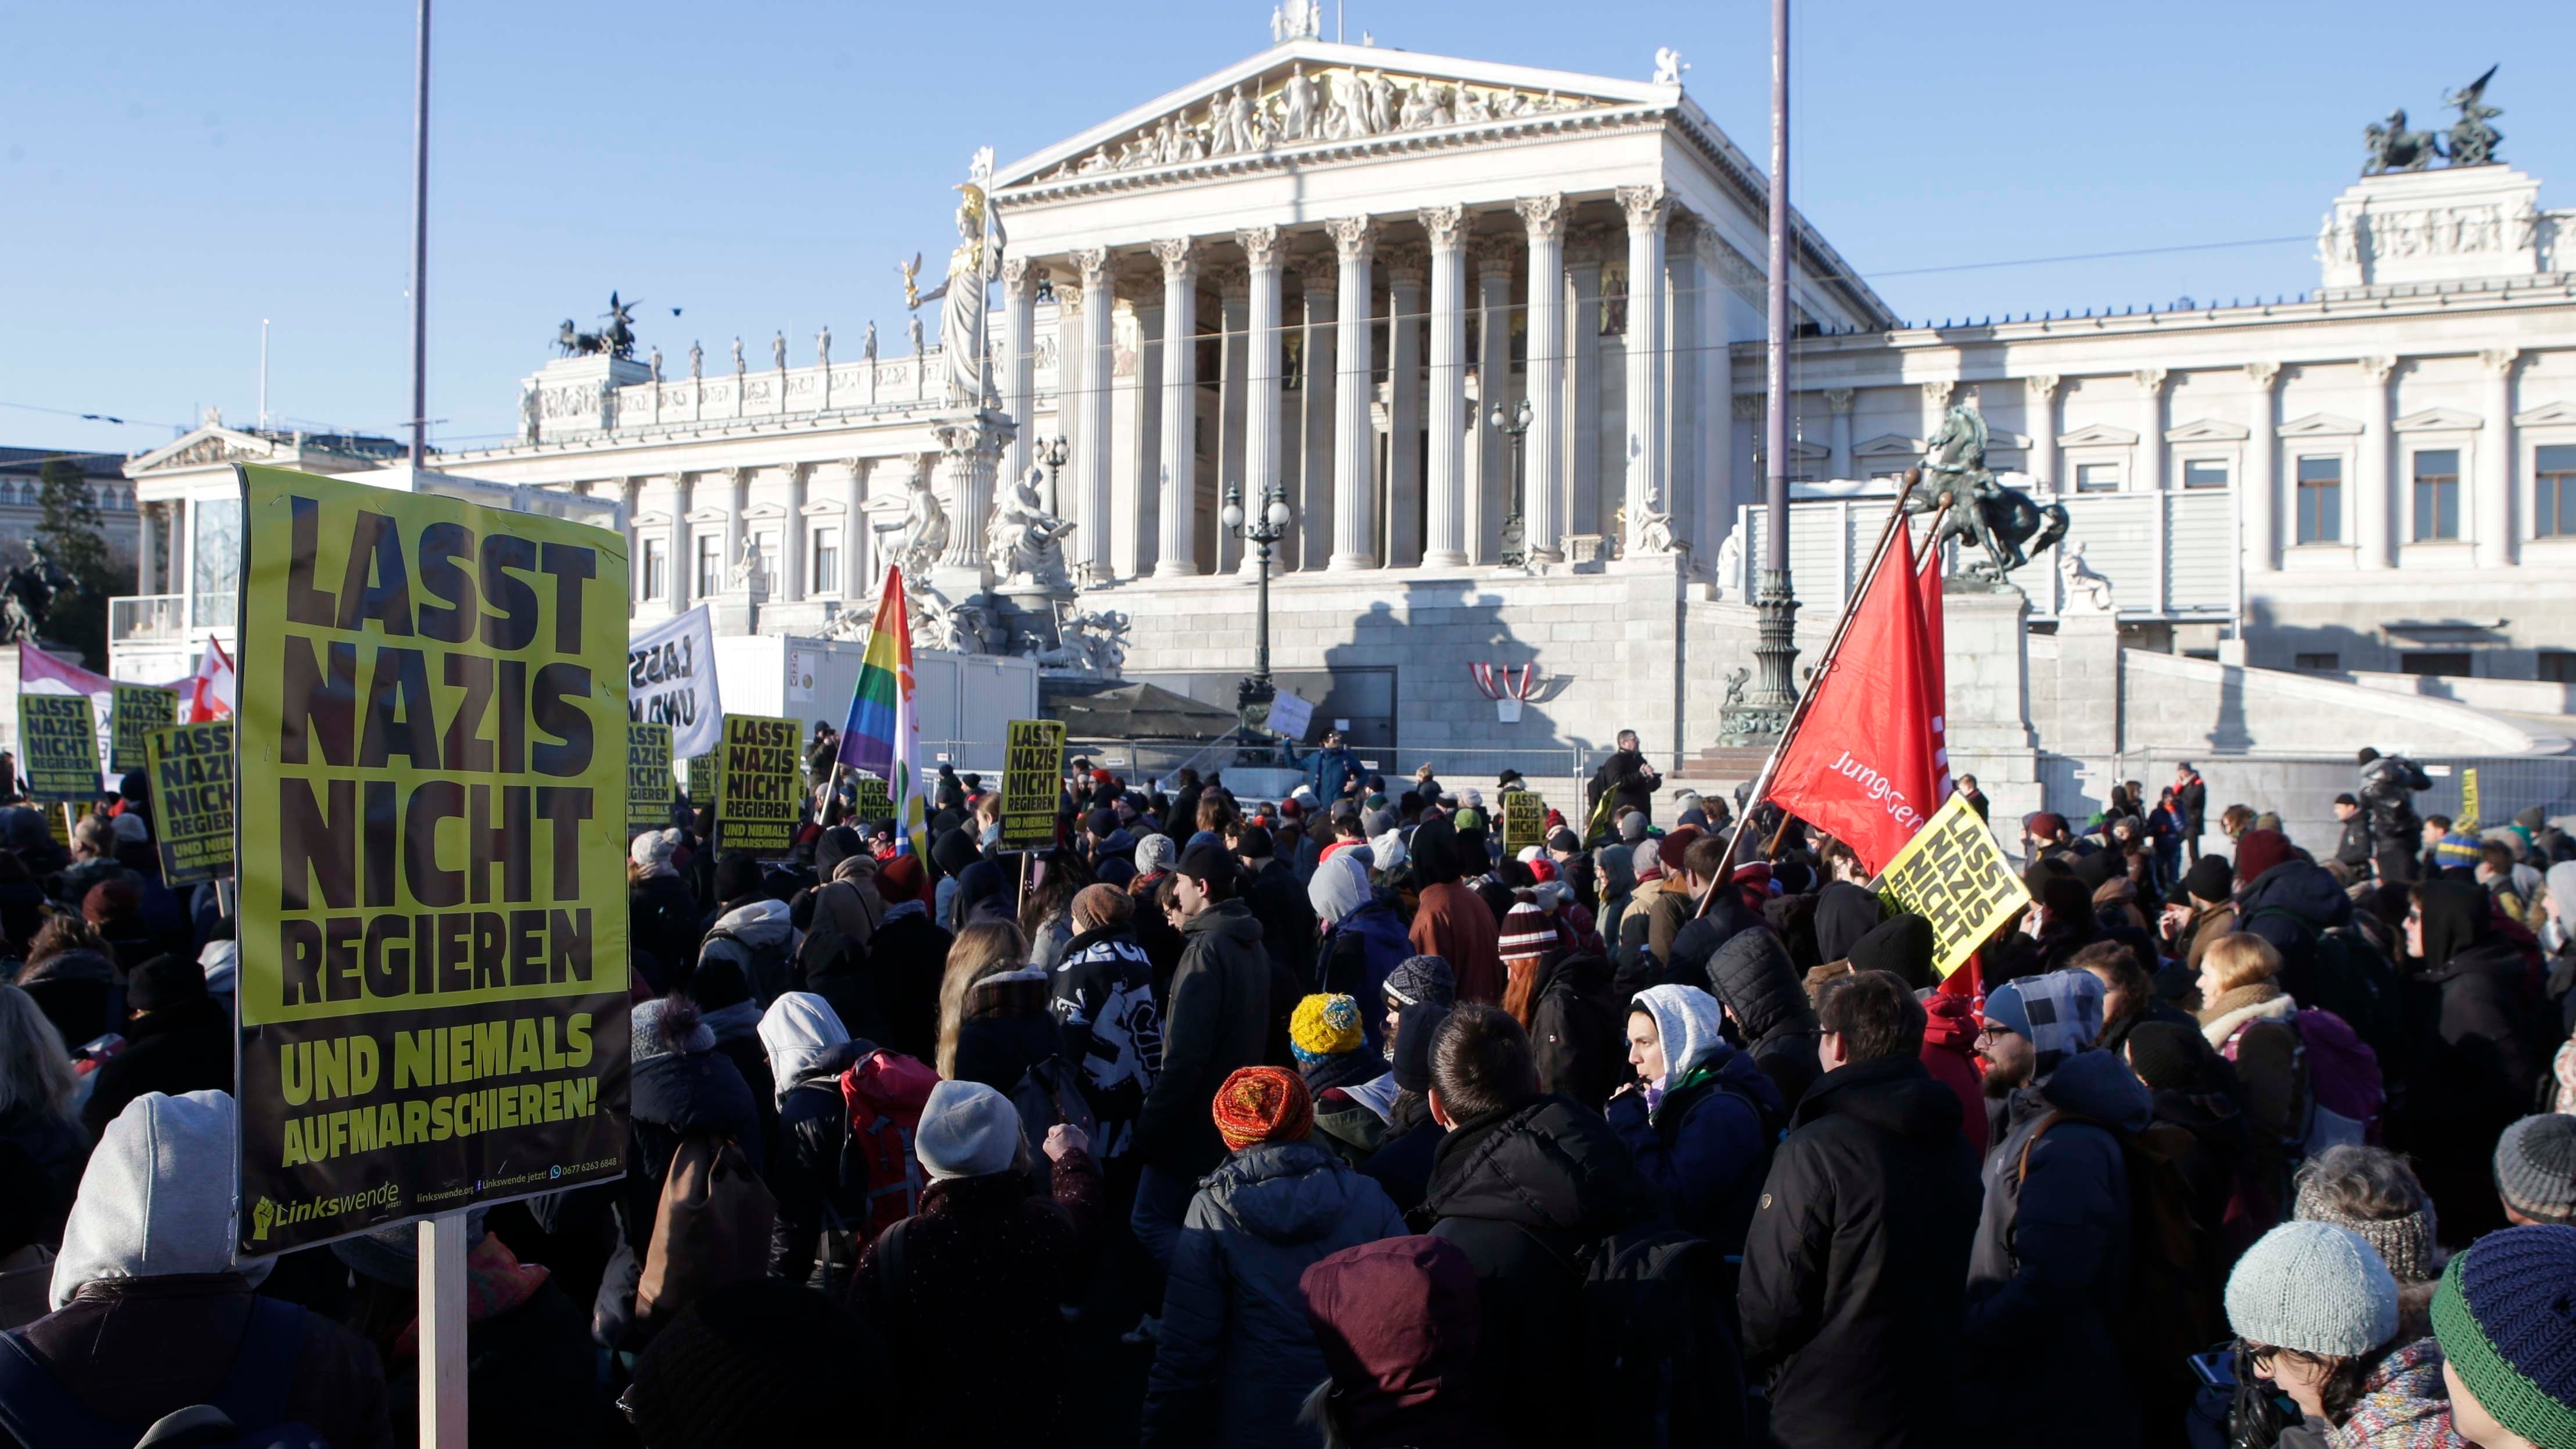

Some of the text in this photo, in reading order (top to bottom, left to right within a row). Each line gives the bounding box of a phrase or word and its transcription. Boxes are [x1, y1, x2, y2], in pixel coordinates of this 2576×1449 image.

[286, 495, 596, 655] LASST
[26, 697, 84, 716] LASST
[119, 688, 172, 706] LASST
[280, 634, 594, 777] NAZIS
[119, 705, 173, 722] NAZIS
[27, 717, 88, 737] NAZIS
[628, 726, 667, 746] ASST
[730, 719, 796, 748] LASST
[1012, 724, 1061, 747] LASST
[30, 737, 89, 756] NICHT
[155, 726, 234, 759] LASS
[32, 756, 92, 769] REGIEREN
[628, 746, 668, 767] AZIS
[728, 746, 794, 774] NAZIS
[1011, 748, 1058, 771] NAZIS
[160, 754, 234, 788] NAZI
[629, 766, 669, 787] ICHT
[628, 788, 670, 801] GIEREN
[727, 773, 793, 801] NICHT
[861, 781, 888, 794] LASS
[1008, 772, 1056, 795] NICHT
[164, 782, 234, 818] NICH
[726, 801, 791, 819] REGIEREN
[1007, 795, 1055, 812] REGIEREN
[1510, 794, 1539, 806] LASST
[1005, 816, 1054, 828] UND NIEMALS
[1509, 807, 1539, 819] NAZIS
[169, 813, 233, 837] REGIER
[724, 824, 789, 838] UND NIEMALS
[1508, 820, 1539, 833] NICHT
[280, 777, 594, 910] NICHT
[1946, 807, 2018, 905] LASST
[1925, 827, 1993, 928] NAZIS
[1905, 848, 1972, 947] NICHT
[280, 908, 592, 1006] REGIEREN
[281, 1013, 592, 1106] UND NIEMALS
[282, 1077, 598, 1168] AUFMARSCHIEREN!
[417, 1185, 474, 1203] linkswende.org
[483, 1176, 526, 1189] Linkswende
[527, 1171, 547, 1183] jetzt!
[562, 1164, 580, 1175] 0677
[581, 1161, 599, 1172] 6263
[600, 1157, 617, 1168] 6848
[275, 1181, 399, 1226] Linkswende
[386, 1200, 401, 1210] jetzt!
